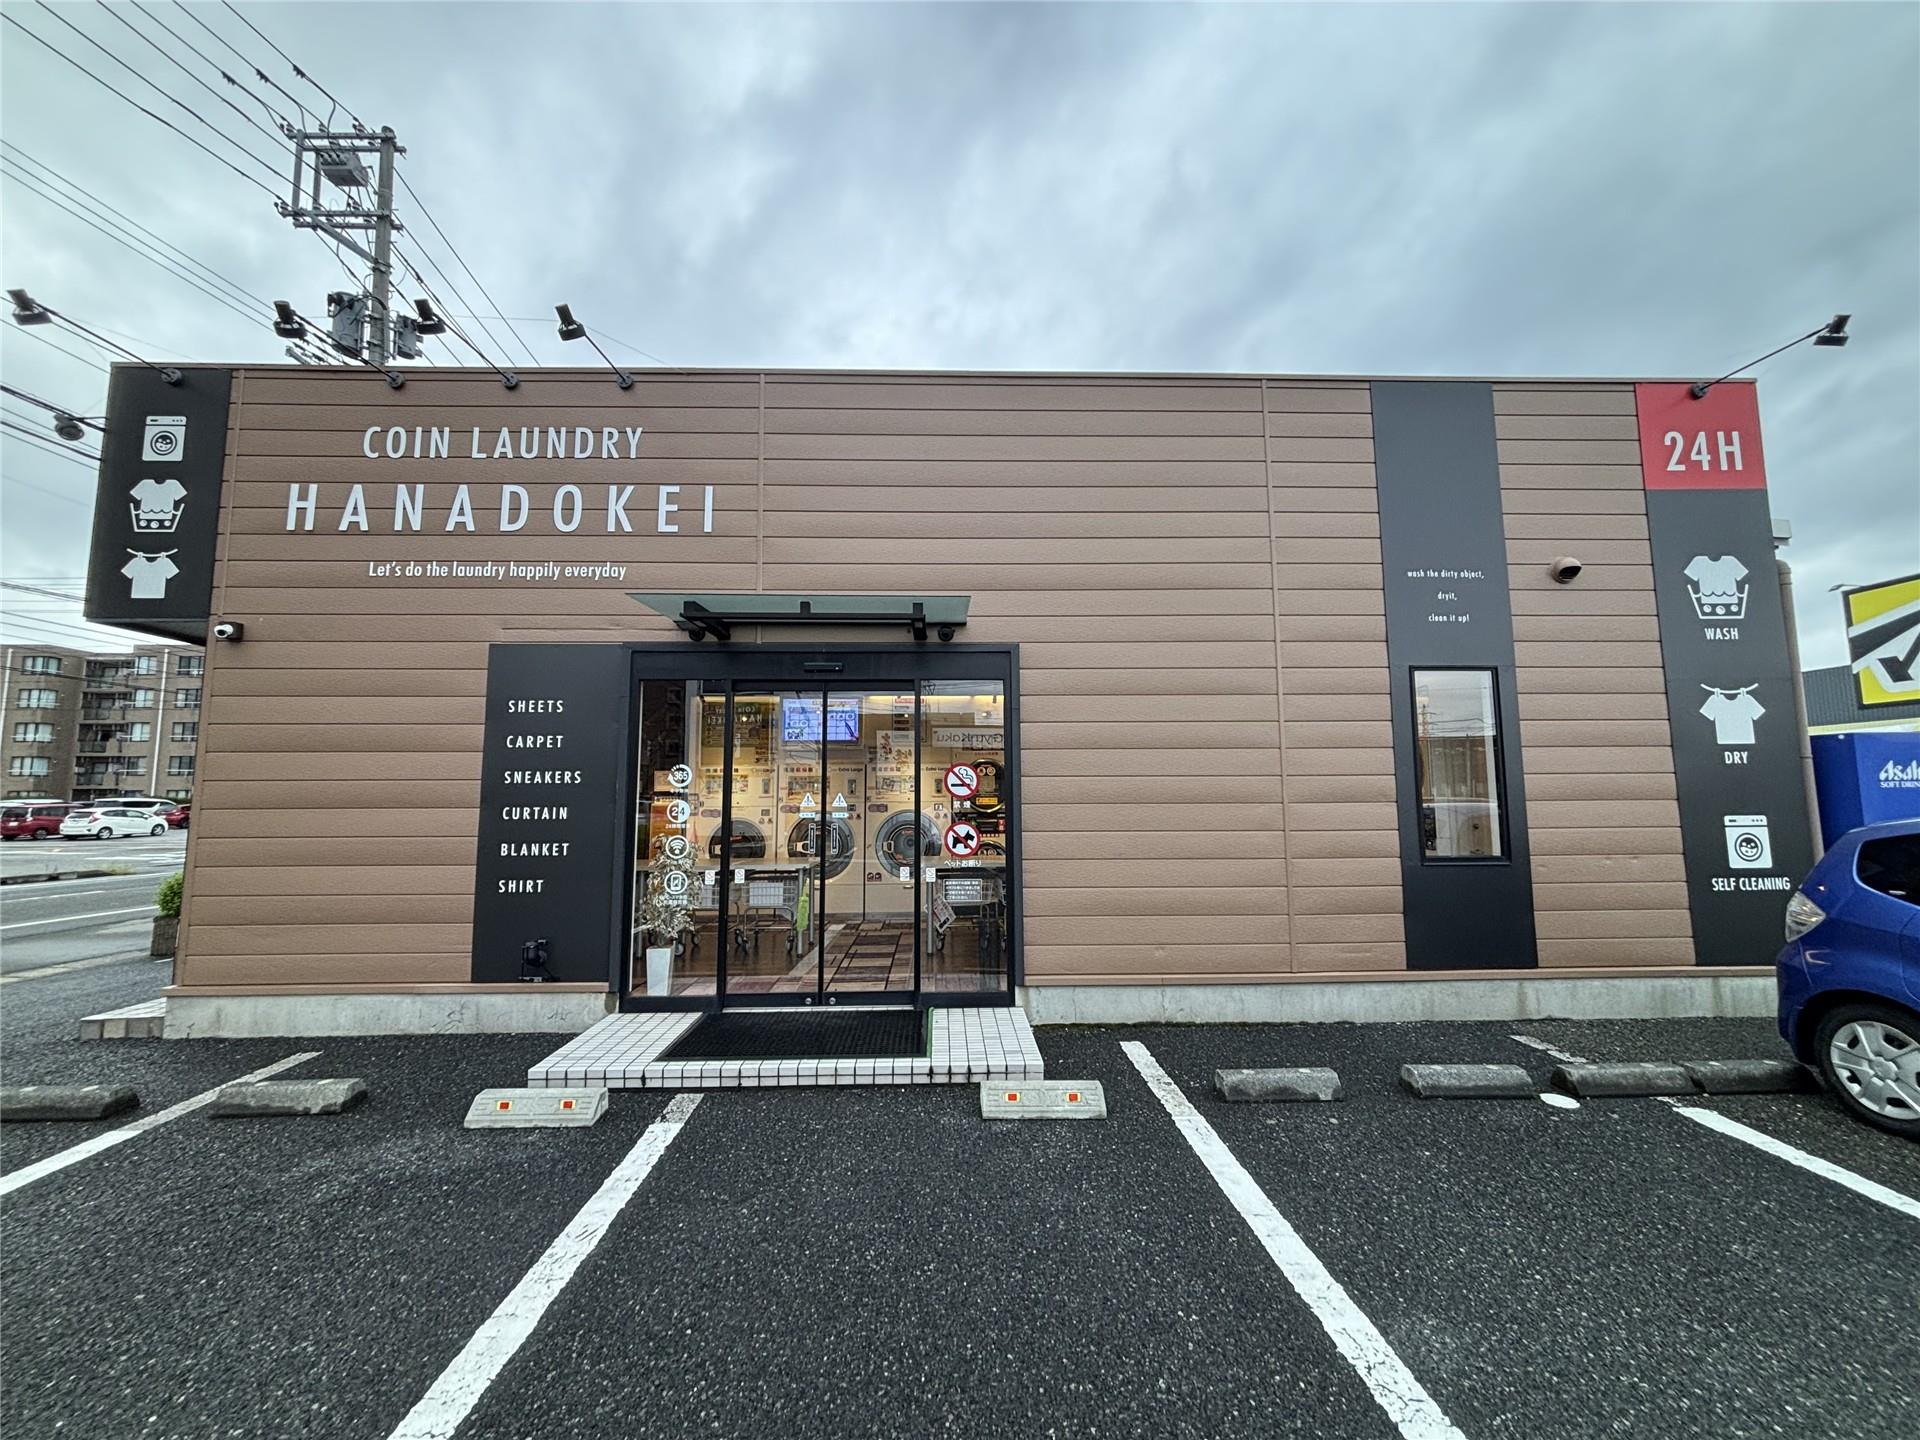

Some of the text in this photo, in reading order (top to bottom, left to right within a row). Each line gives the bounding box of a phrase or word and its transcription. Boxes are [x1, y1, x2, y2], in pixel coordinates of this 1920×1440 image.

[362, 425, 644, 461] COIN LAUNDRY
[1663, 430, 1744, 472] 24H
[284, 483, 714, 533] HANADOKEI
[368, 561, 627, 581] Let's do the laundry happily everyday
[1407, 569, 1485, 580] wash the dirty object,
[1428, 613, 1470, 623] clean it up!
[1704, 627, 1739, 641] WASH
[507, 699, 564, 713] SHEETS
[506, 735, 564, 749] CARPET
[1724, 750, 1749, 765] DRY
[503, 770, 582, 784] SNEAKERS
[673, 771, 688, 781] 365
[1880, 780, 1900, 788] SOFT
[502, 806, 569, 821] CURTAIN
[671, 806, 685, 816] 24
[500, 843, 570, 857] BLANKET
[498, 879, 544, 893] SHIRT
[1712, 876, 1791, 893] SELF CLEANING
